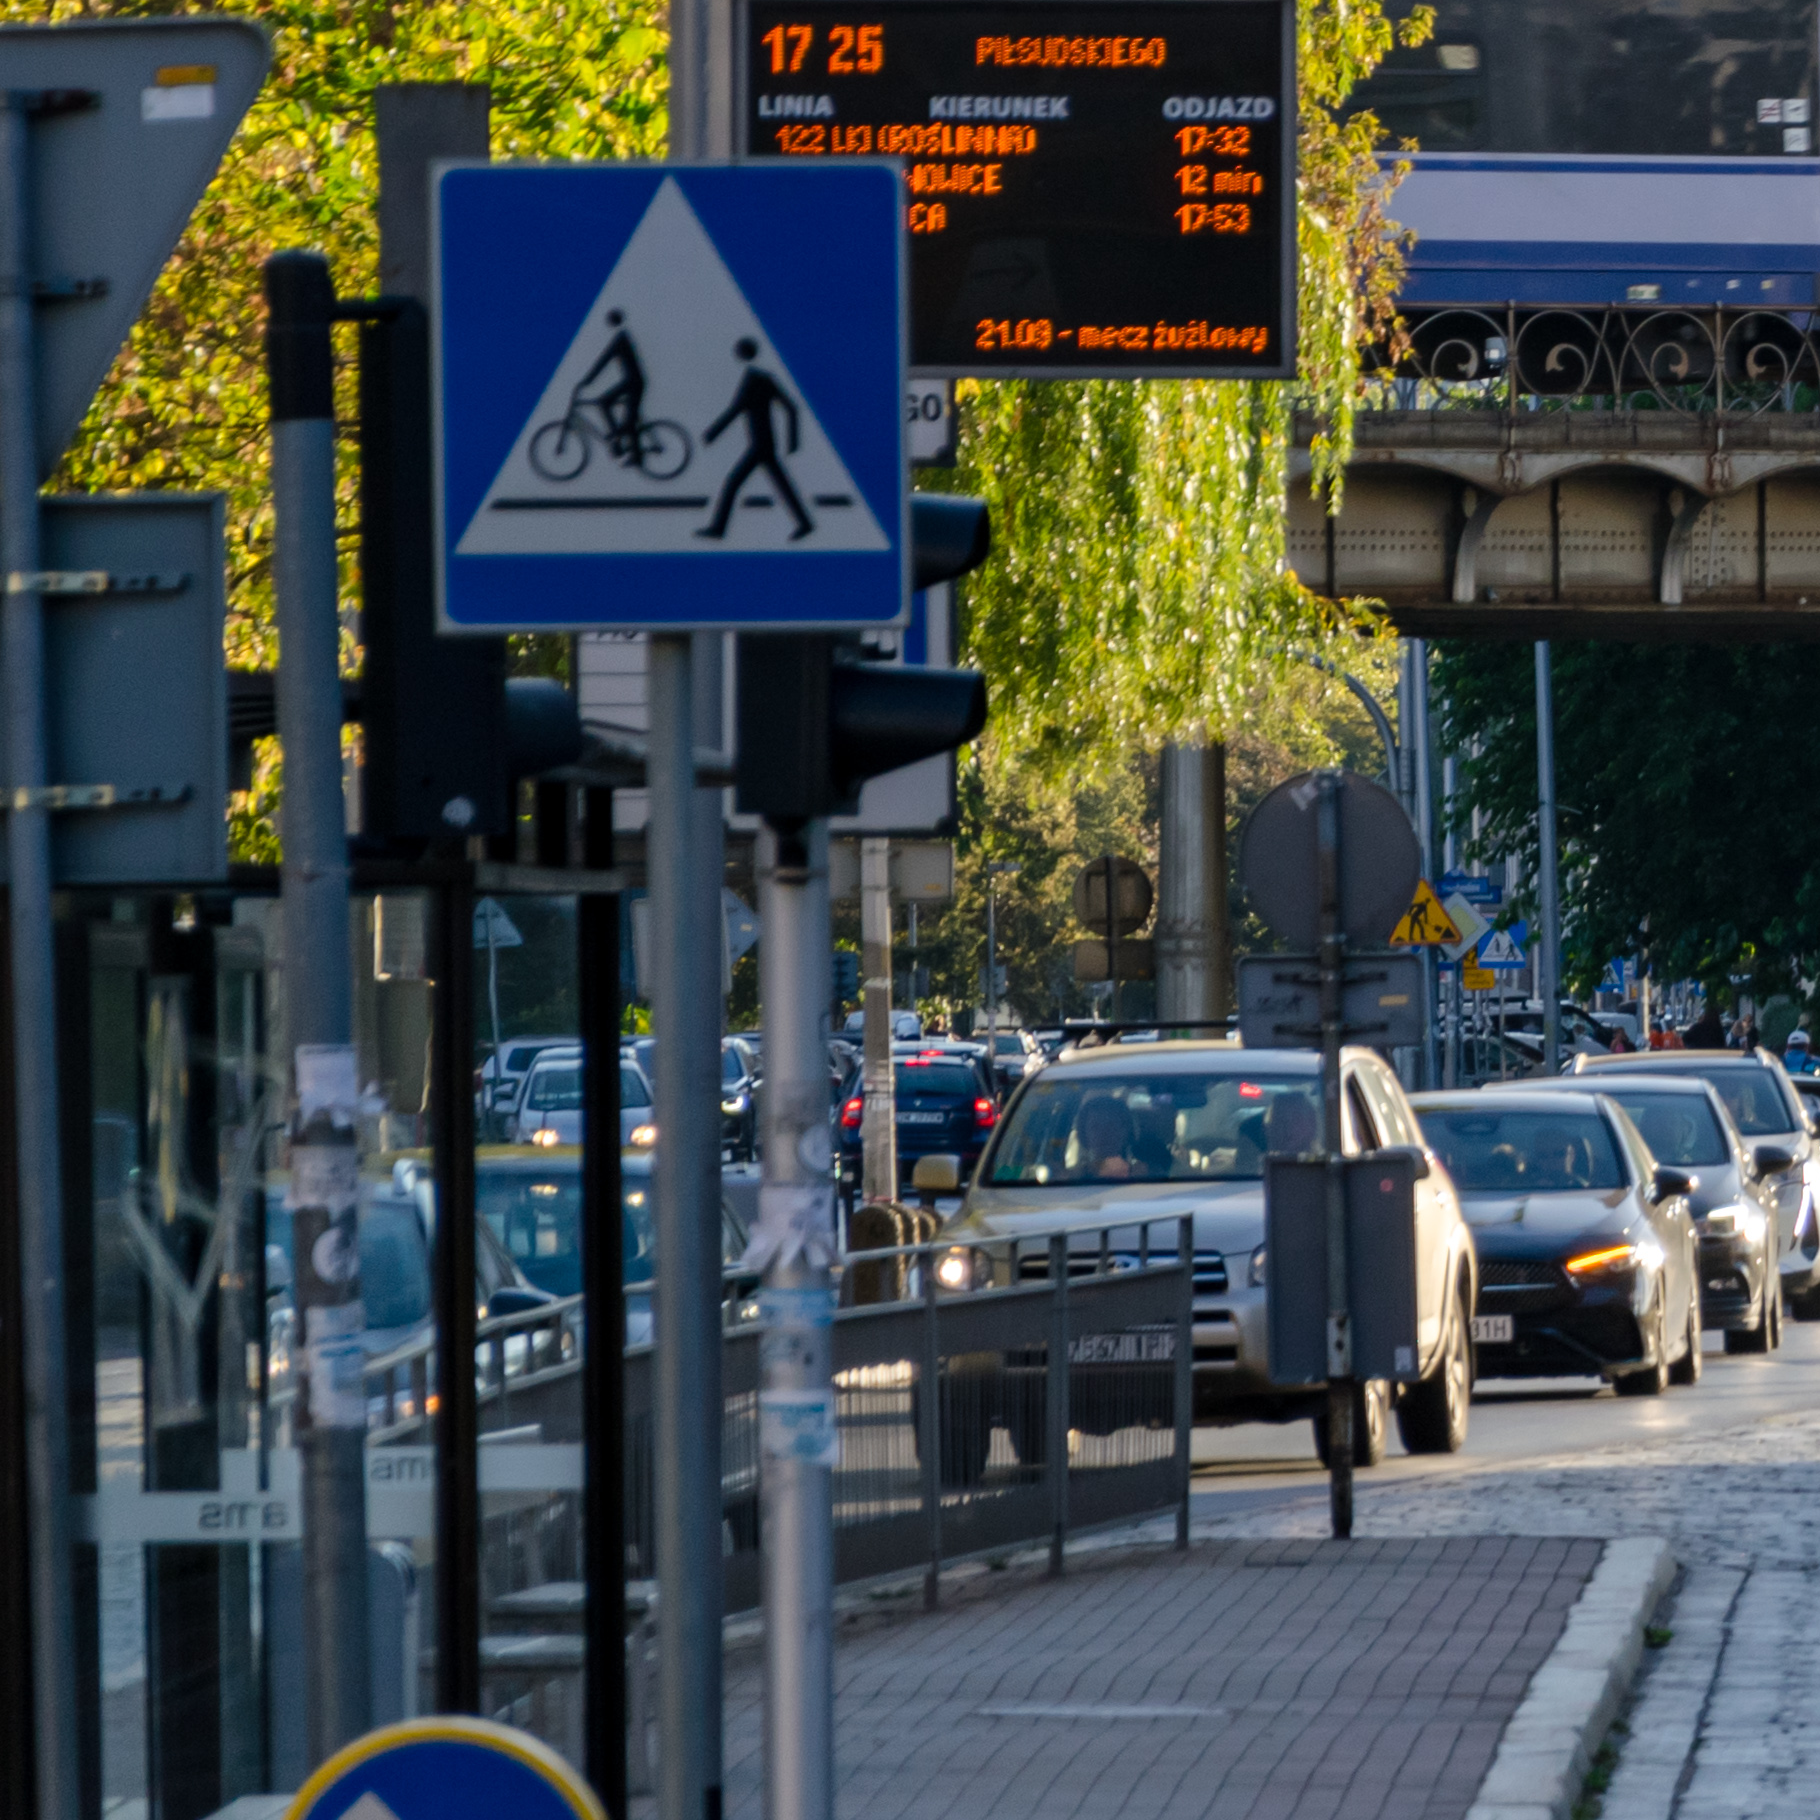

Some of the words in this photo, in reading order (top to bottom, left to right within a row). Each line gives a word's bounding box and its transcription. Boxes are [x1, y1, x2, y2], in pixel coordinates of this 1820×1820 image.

[761, 24, 814, 75] 17
[827, 24, 885, 74] 25
[758, 96, 834, 118] LINIA
[929, 96, 1069, 119] KIERUNEK
[1163, 97, 1275, 119] ODJAZD
[775, 124, 827, 156] 122
[1174, 164, 1208, 196] 12
[1213, 164, 1264, 197] min
